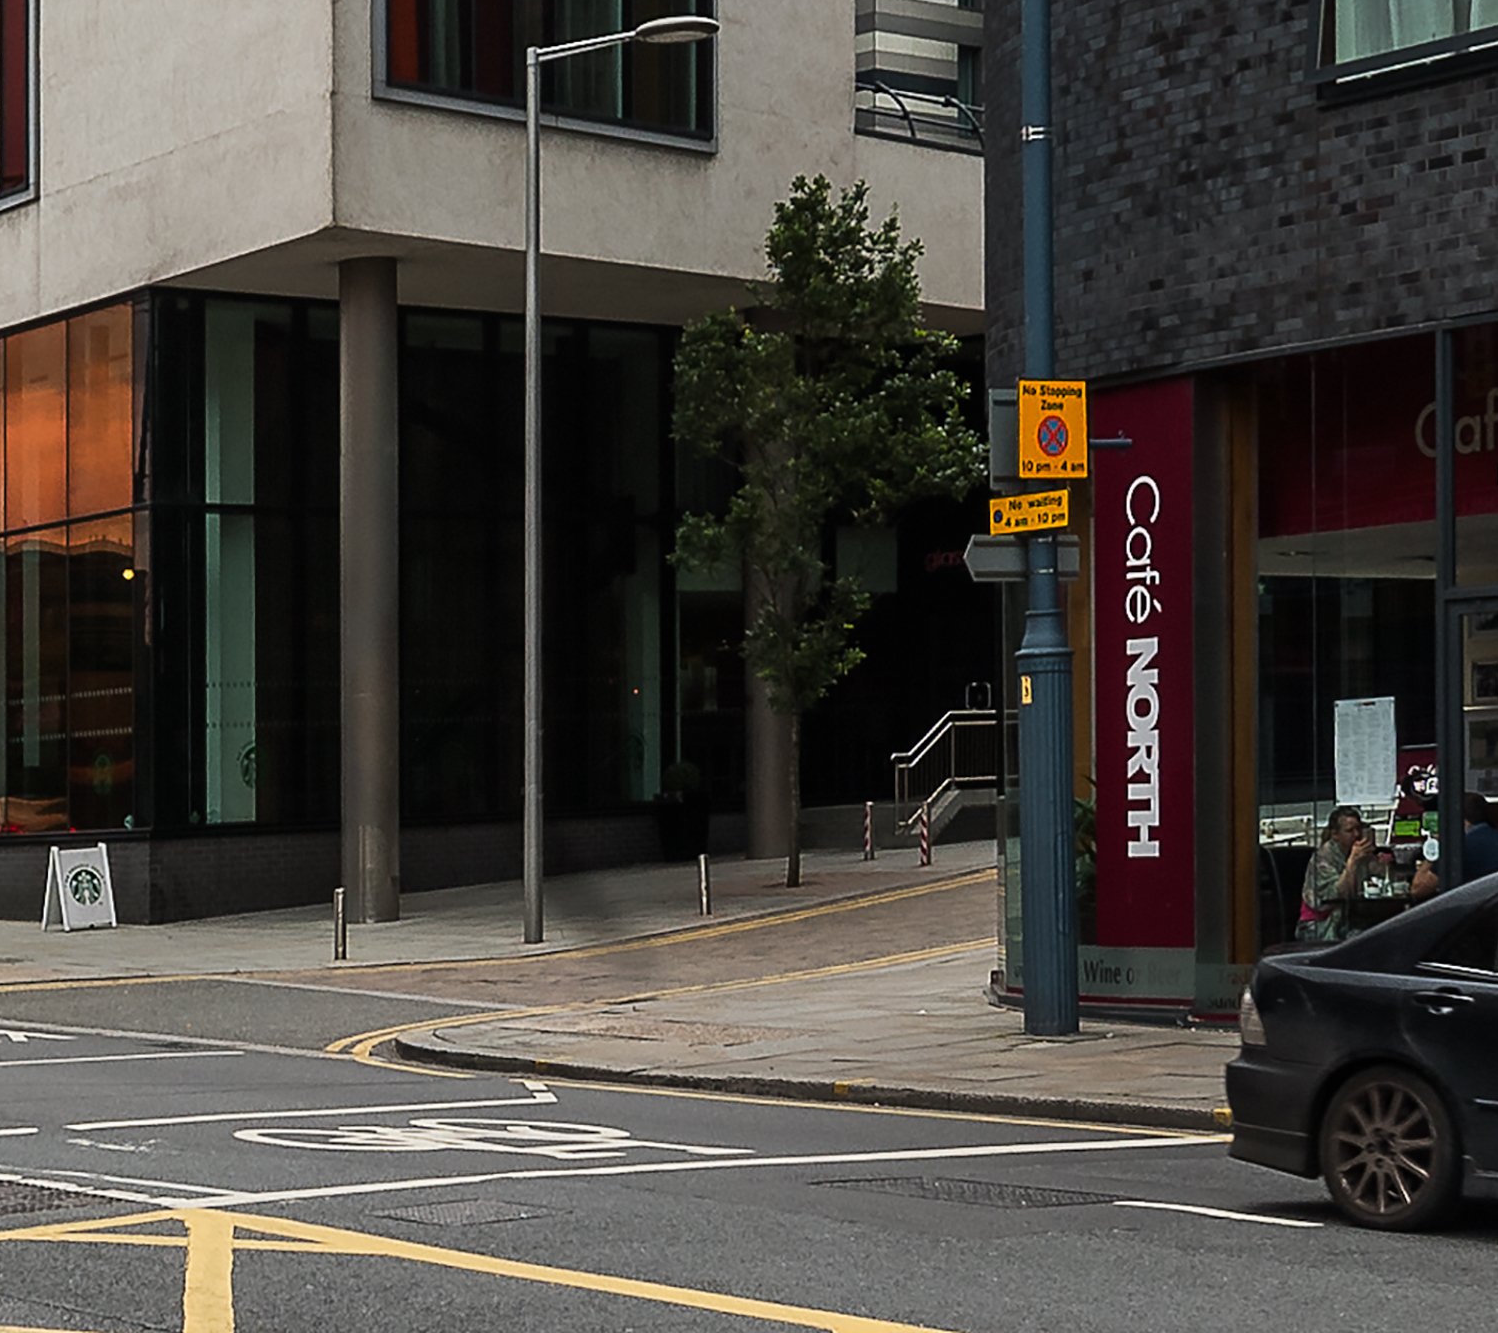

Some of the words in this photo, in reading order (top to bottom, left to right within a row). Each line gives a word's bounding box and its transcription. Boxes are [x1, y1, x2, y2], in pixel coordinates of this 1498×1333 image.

[1023, 385, 1036, 395] No
[1040, 385, 1082, 398] Stopping
[1041, 400, 1064, 411] Zone
[1022, 461, 1033, 471] 10
[1036, 463, 1051, 473] pm
[1061, 461, 1068, 471] 4
[1071, 462, 1084, 471] am
[1009, 501, 1022, 511] No
[1028, 495, 1063, 509] waiting
[1126, 475, 1162, 624] Café
[1126, 636, 1160, 858] NORTH
[1084, 960, 1121, 984] Wine
